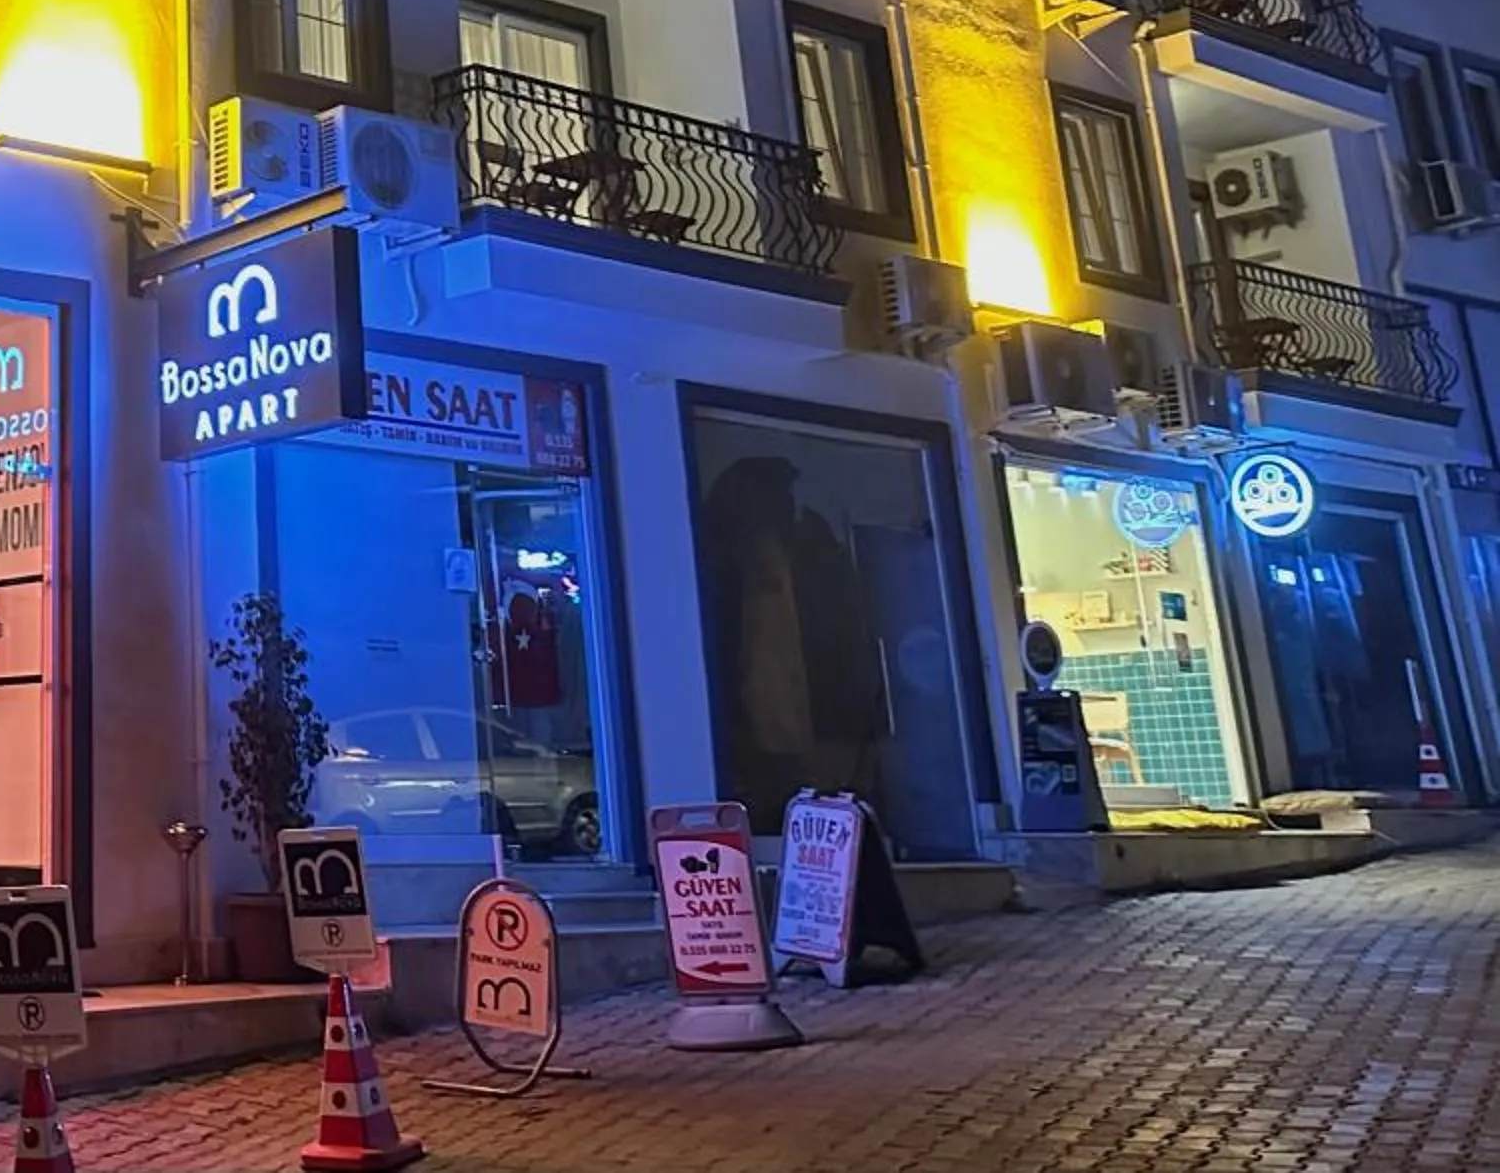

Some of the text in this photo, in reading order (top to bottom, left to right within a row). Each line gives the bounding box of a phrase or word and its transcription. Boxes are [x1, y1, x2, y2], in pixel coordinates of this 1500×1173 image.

[161, 332, 332, 404] BossaNova
[195, 387, 299, 442] APART
[426, 379, 517, 431] SAAT
[791, 812, 851, 851] GÜVEN
[797, 843, 836, 871] SAAT
[674, 875, 742, 897] GÜVEN
[686, 898, 736, 917] SAAT
